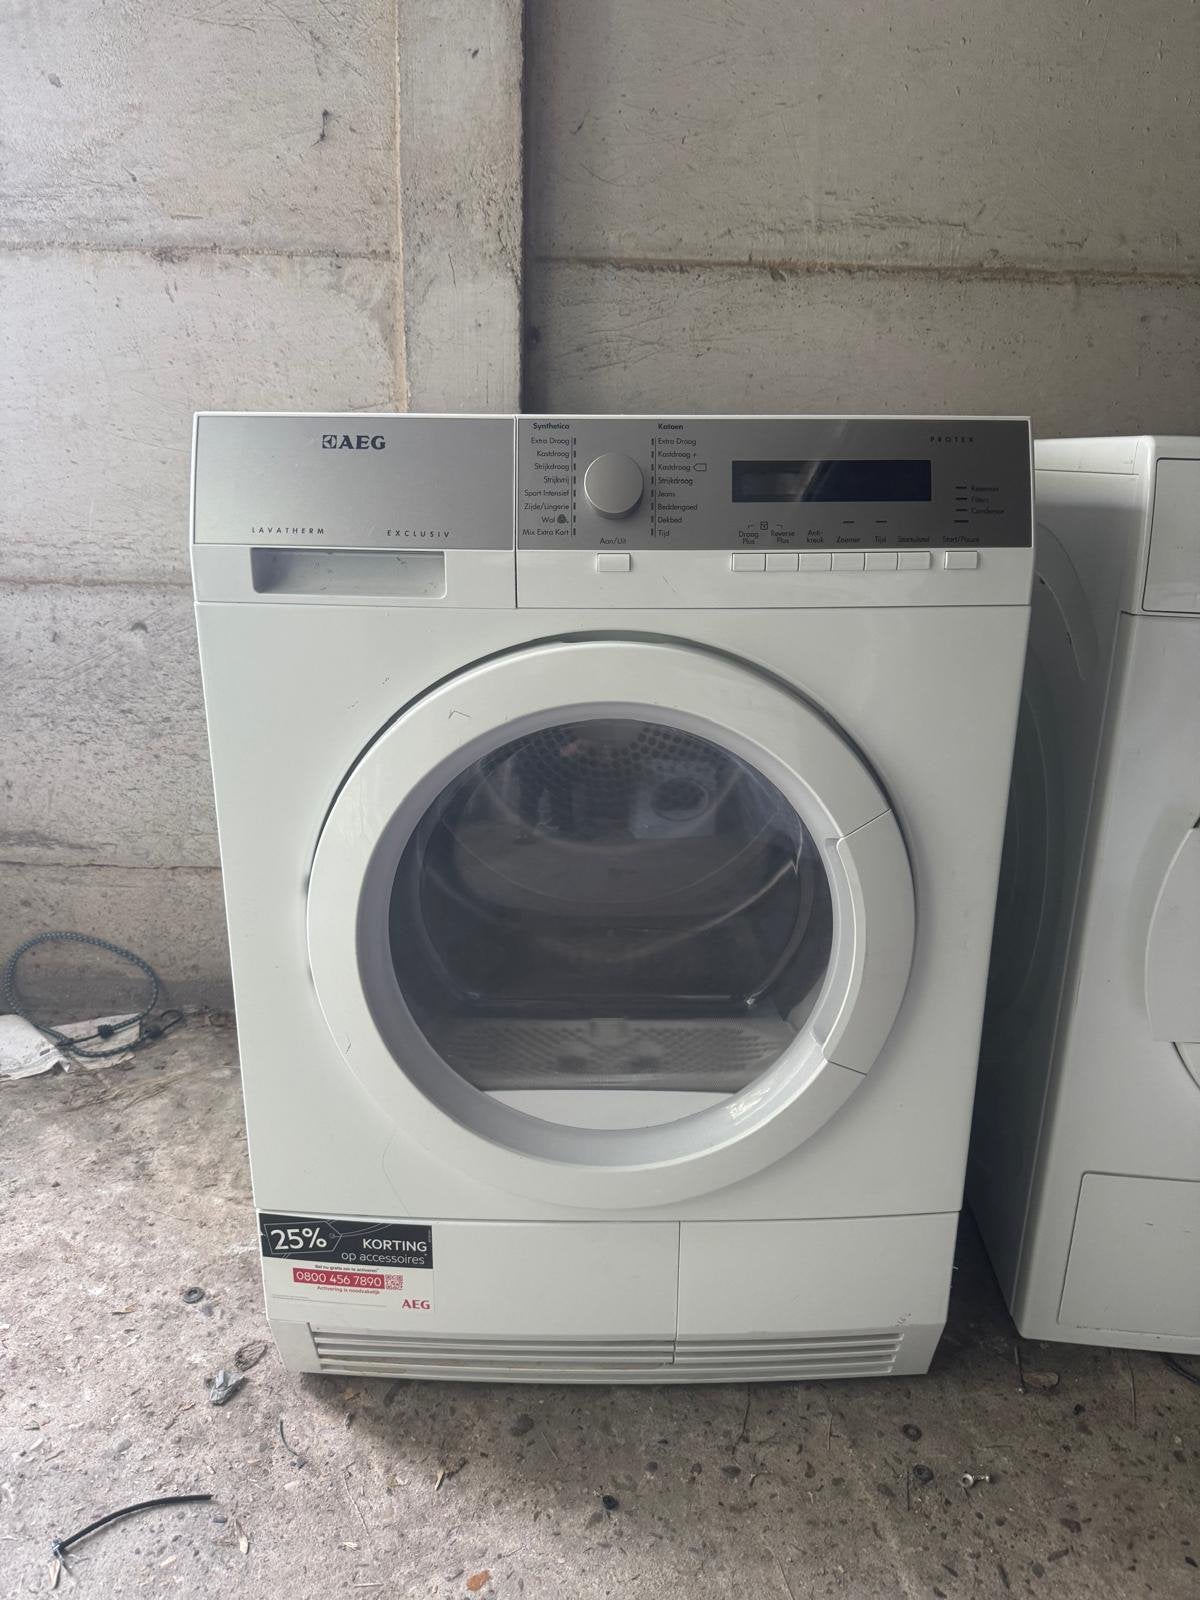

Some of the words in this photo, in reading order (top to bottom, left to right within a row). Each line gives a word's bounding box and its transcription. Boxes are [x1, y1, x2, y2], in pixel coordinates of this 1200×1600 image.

[338, 435, 386, 450] AEG
[549, 438, 569, 446] Droog
[676, 438, 697, 446] Droog
[536, 450, 569, 458] Kastdroog
[658, 450, 691, 459] Kastdroog
[534, 463, 569, 471] Strijkdroog
[658, 463, 691, 472] Kastdroog
[543, 476, 569, 484] Strijkvrij
[658, 476, 693, 485] Strijkdroog
[524, 489, 542, 497] Sport
[658, 490, 675, 498] Jeans
[658, 503, 698, 512] Beddengoed
[251, 527, 325, 535] LAVATHERM
[387, 530, 450, 538] EXCLUSIV
[658, 529, 670, 537] Tijd
[738, 531, 759, 539] Droog
[600, 537, 627, 545] Aan/Uit
[270, 1228, 327, 1250] 25%
[362, 1238, 427, 1252] KORTING
[341, 1252, 357, 1261] op
[296, 1271, 327, 1283] 0800
[330, 1274, 350, 1284] 456
[353, 1275, 382, 1287] 7890
[402, 1299, 430, 1310] AEG
